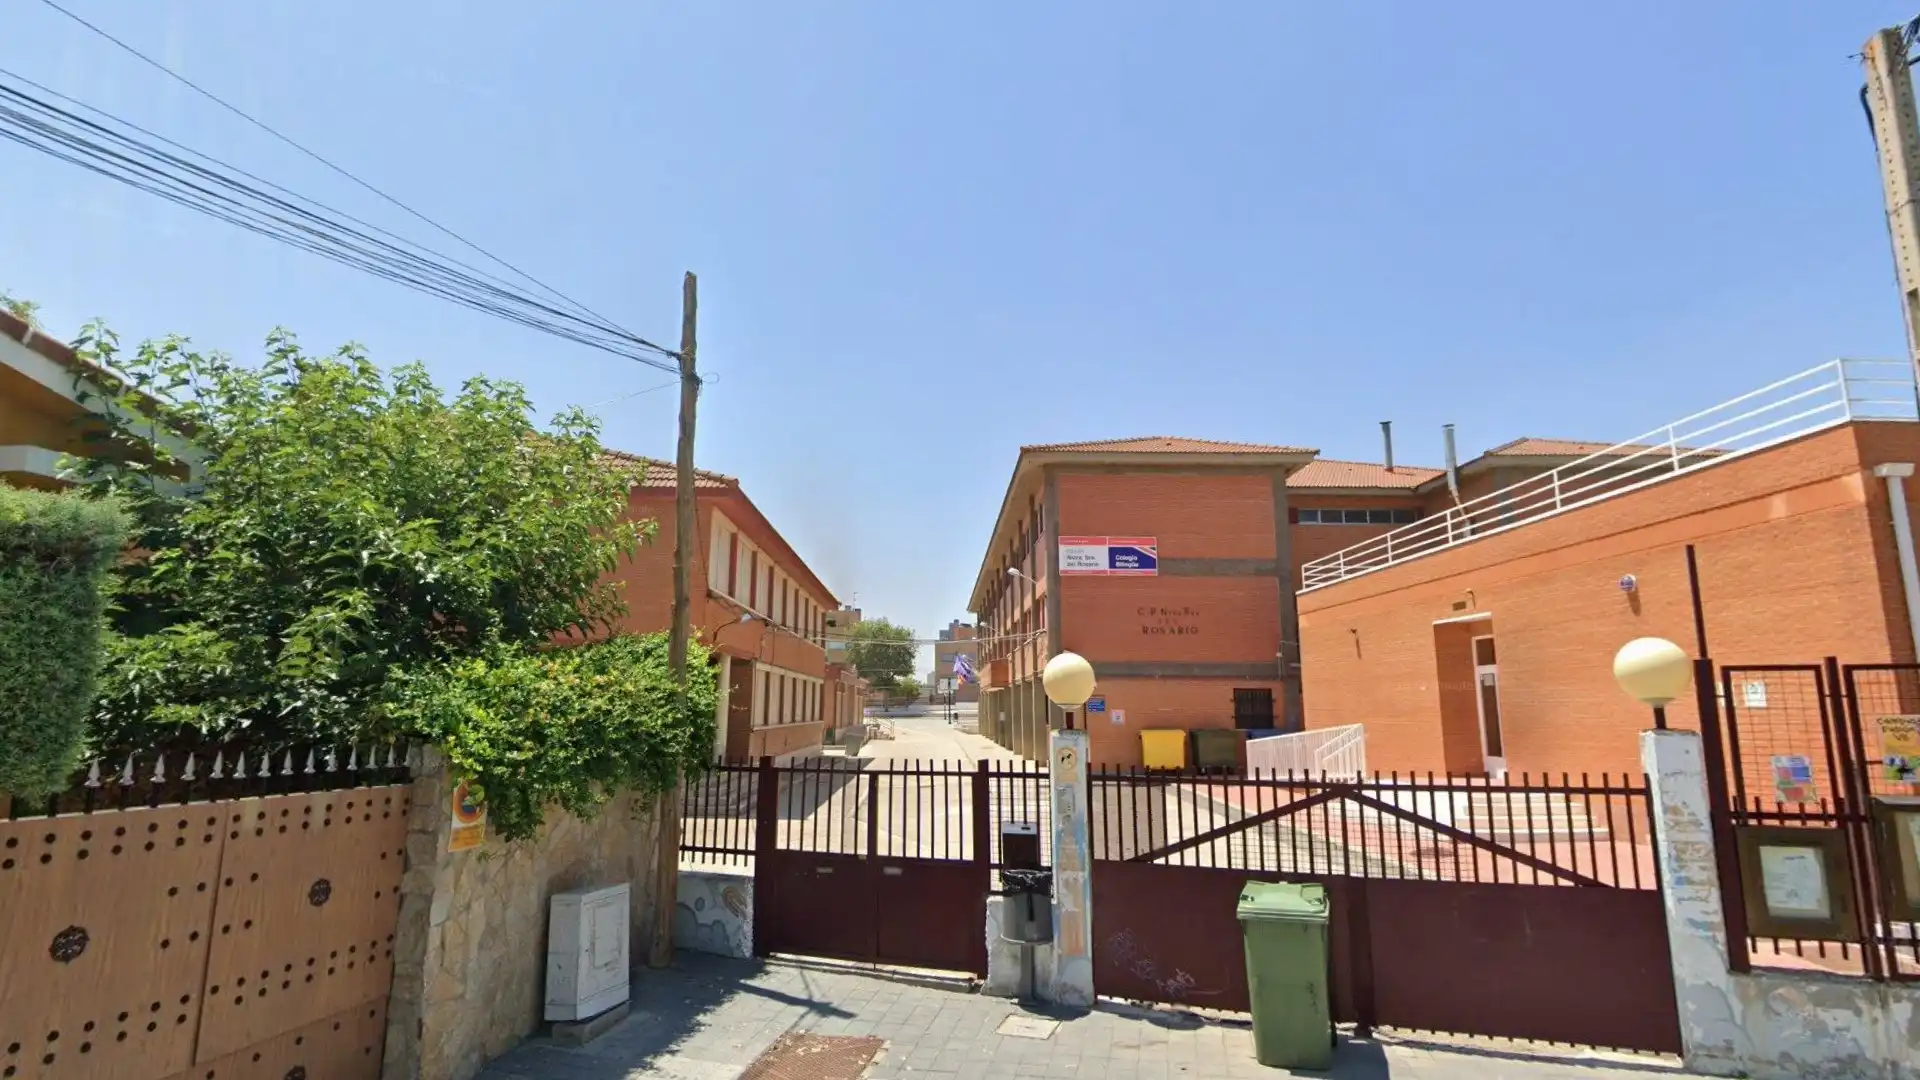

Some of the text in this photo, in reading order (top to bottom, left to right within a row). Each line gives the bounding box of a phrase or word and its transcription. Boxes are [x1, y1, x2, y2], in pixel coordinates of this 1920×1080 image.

[1115, 554, 1138, 562] Colegio
[1115, 561, 1139, 569] Bilingüe
[1142, 625, 1199, 636] ROSARIO
